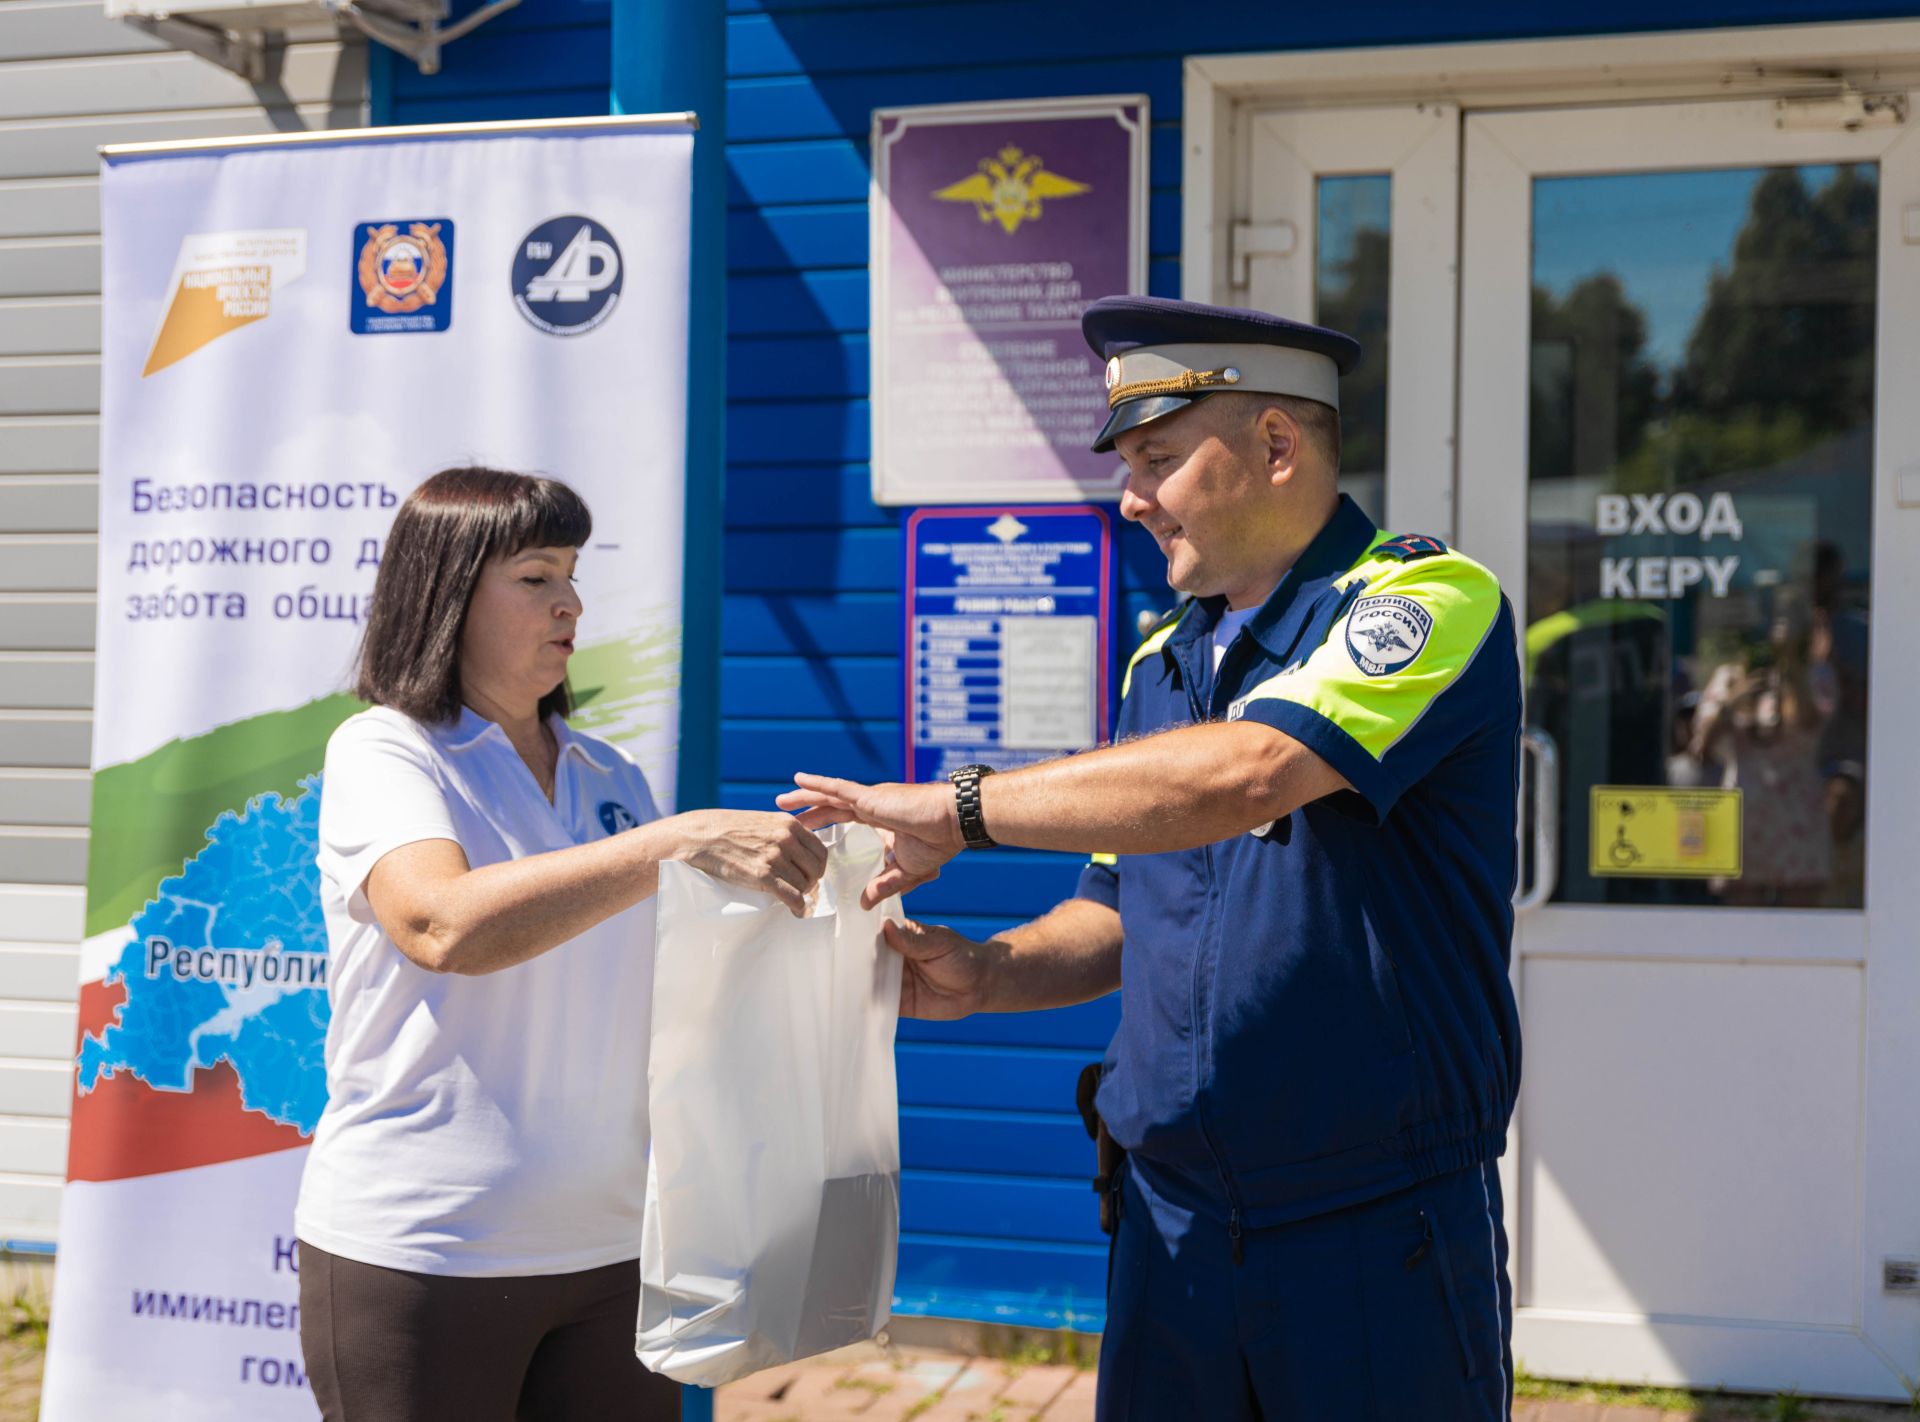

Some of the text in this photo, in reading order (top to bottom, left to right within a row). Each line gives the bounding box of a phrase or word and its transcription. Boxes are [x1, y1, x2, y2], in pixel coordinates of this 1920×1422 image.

[132, 477, 399, 514] Безопасность
[1596, 491, 1743, 542] ВХОД
[127, 536, 331, 578] дорожного
[126, 587, 246, 621] забота
[1359, 597, 1428, 626] ПОЛИЦИЯ
[1358, 610, 1418, 639] РОССИЯ
[1360, 655, 1387, 675] МВД
[148, 939, 327, 989] Республи
